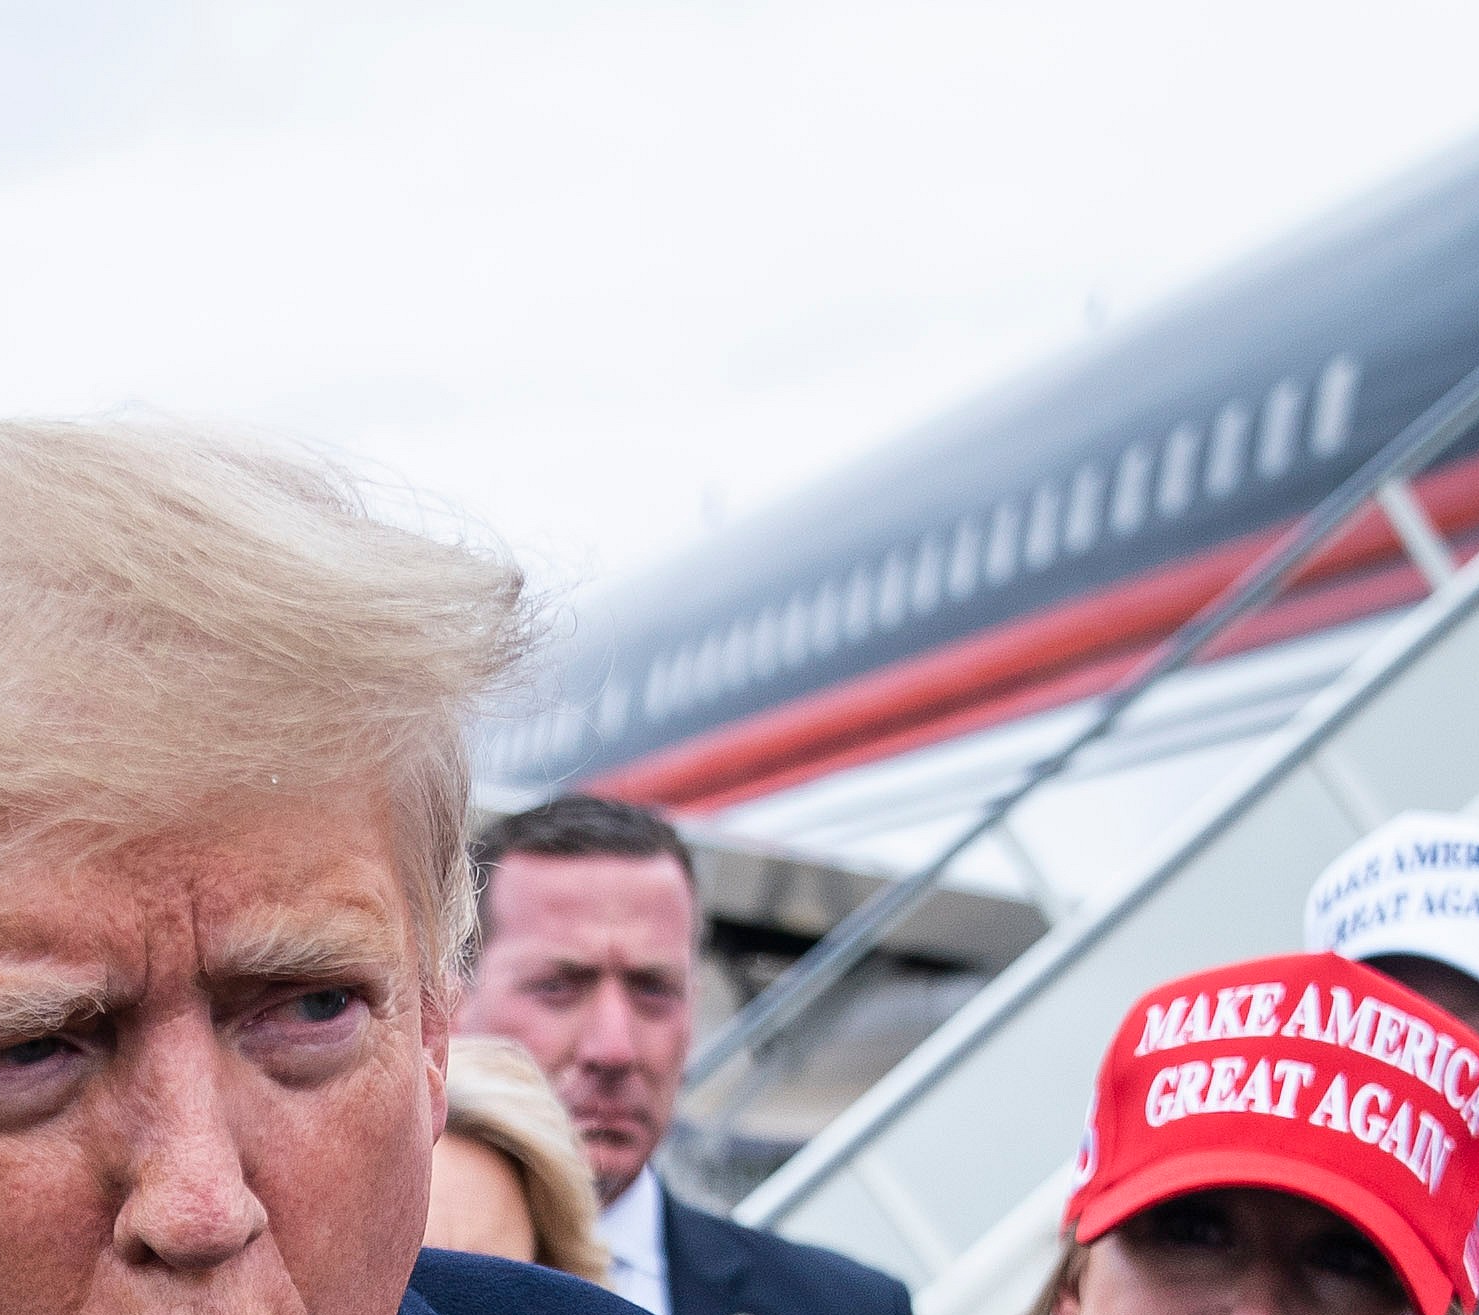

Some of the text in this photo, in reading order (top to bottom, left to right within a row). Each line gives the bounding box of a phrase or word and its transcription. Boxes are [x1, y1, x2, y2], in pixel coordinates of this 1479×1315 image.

[1134, 981, 1288, 1057] MAKE
[1145, 1055, 1457, 1196] GREAT AGAIN
